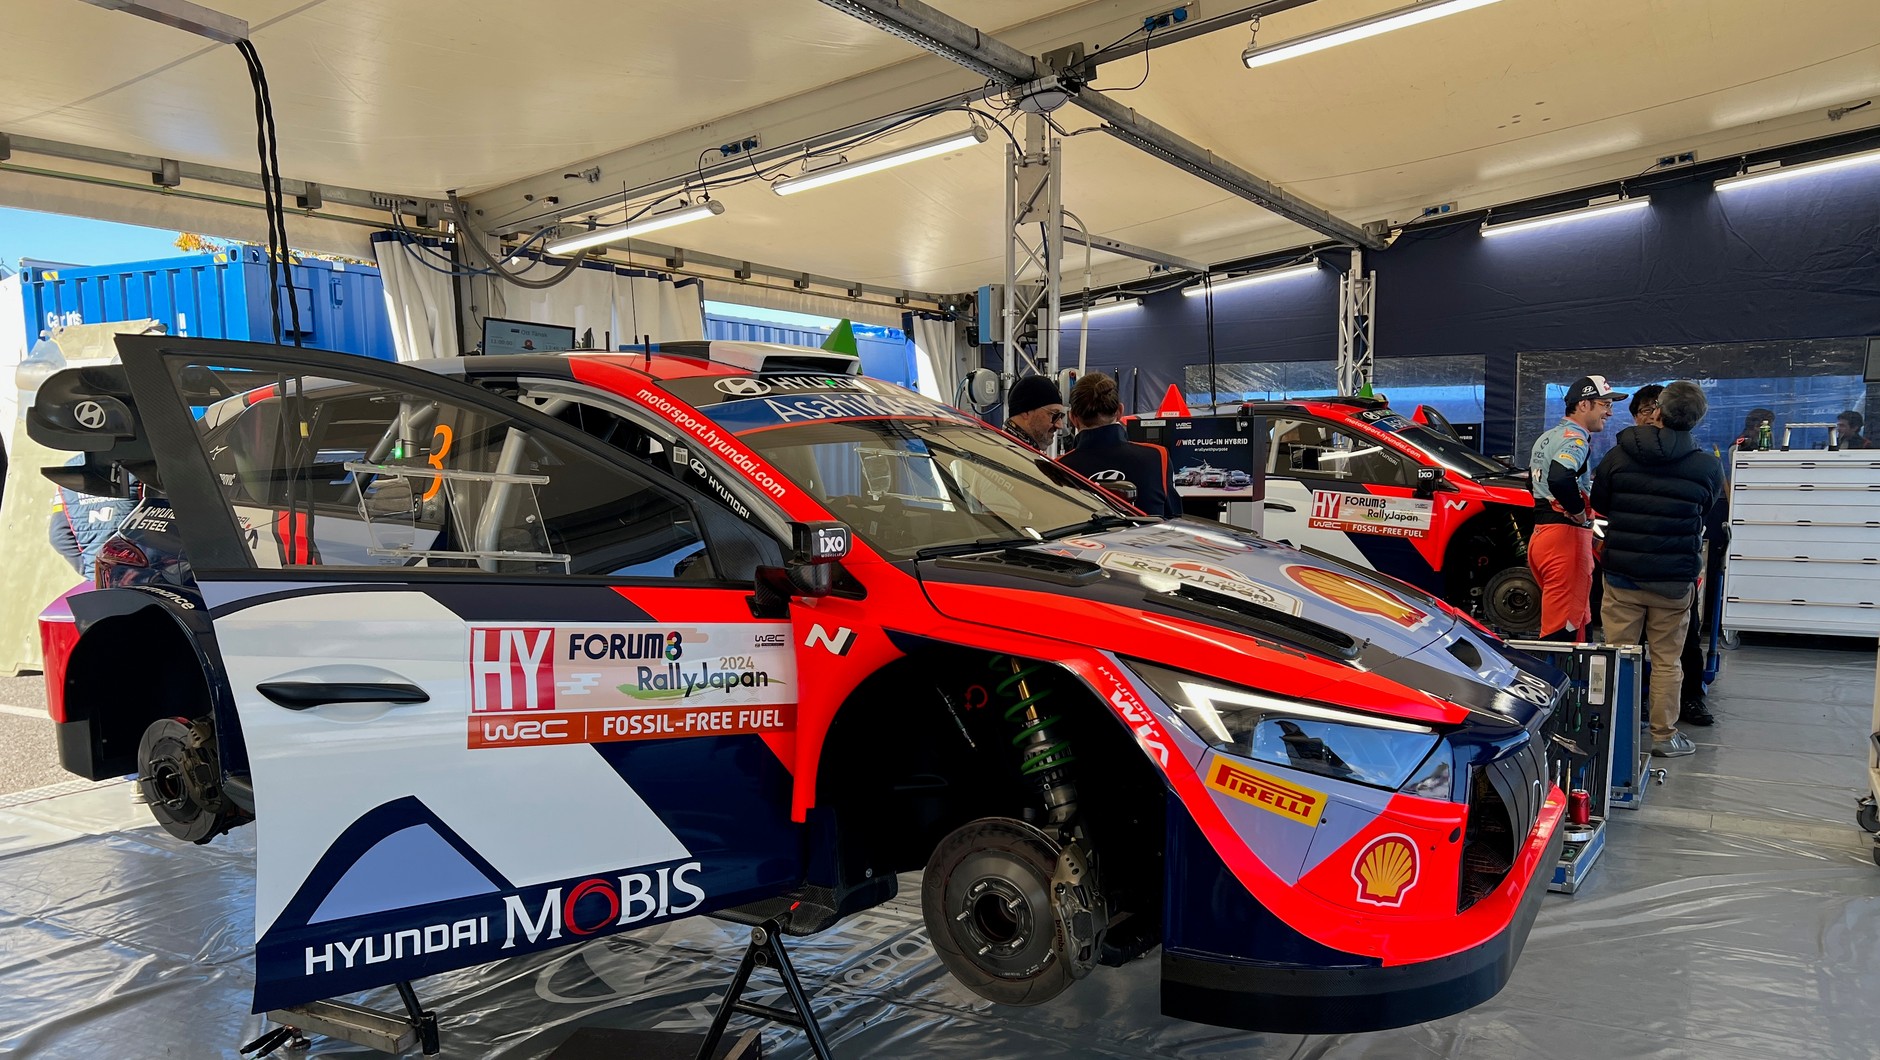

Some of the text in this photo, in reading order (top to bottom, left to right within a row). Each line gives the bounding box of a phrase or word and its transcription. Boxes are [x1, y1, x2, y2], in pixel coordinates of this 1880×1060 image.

[636, 388, 786, 498] motorsport.hyundai.com
[1196, 438, 1223, 446] PLUG-IN
[146, 506, 176, 519] HYUN
[708, 475, 750, 519] HYUNDAI
[1312, 491, 1341, 518] HY
[138, 519, 169, 532] STEEL
[1352, 523, 1402, 536] FOSSIL-FREE
[1403, 529, 1424, 538] FUEL
[1367, 509, 1419, 523] RallyJapan
[818, 529, 845, 553] ixo
[569, 630, 683, 661] FORUM8
[755, 634, 785, 642] WRC
[471, 629, 552, 711] HY
[719, 656, 755, 670] 2024
[637, 661, 769, 698] RallyJapan
[1097, 666, 1157, 727] HYUNDAI
[484, 709, 784, 742] WRC FOSSIL-FREE FUEL
[1215, 764, 1316, 818] PIRELLI
[305, 862, 706, 976] HYUNDAI MOBIS
[1055, 920, 1065, 953] brembo
